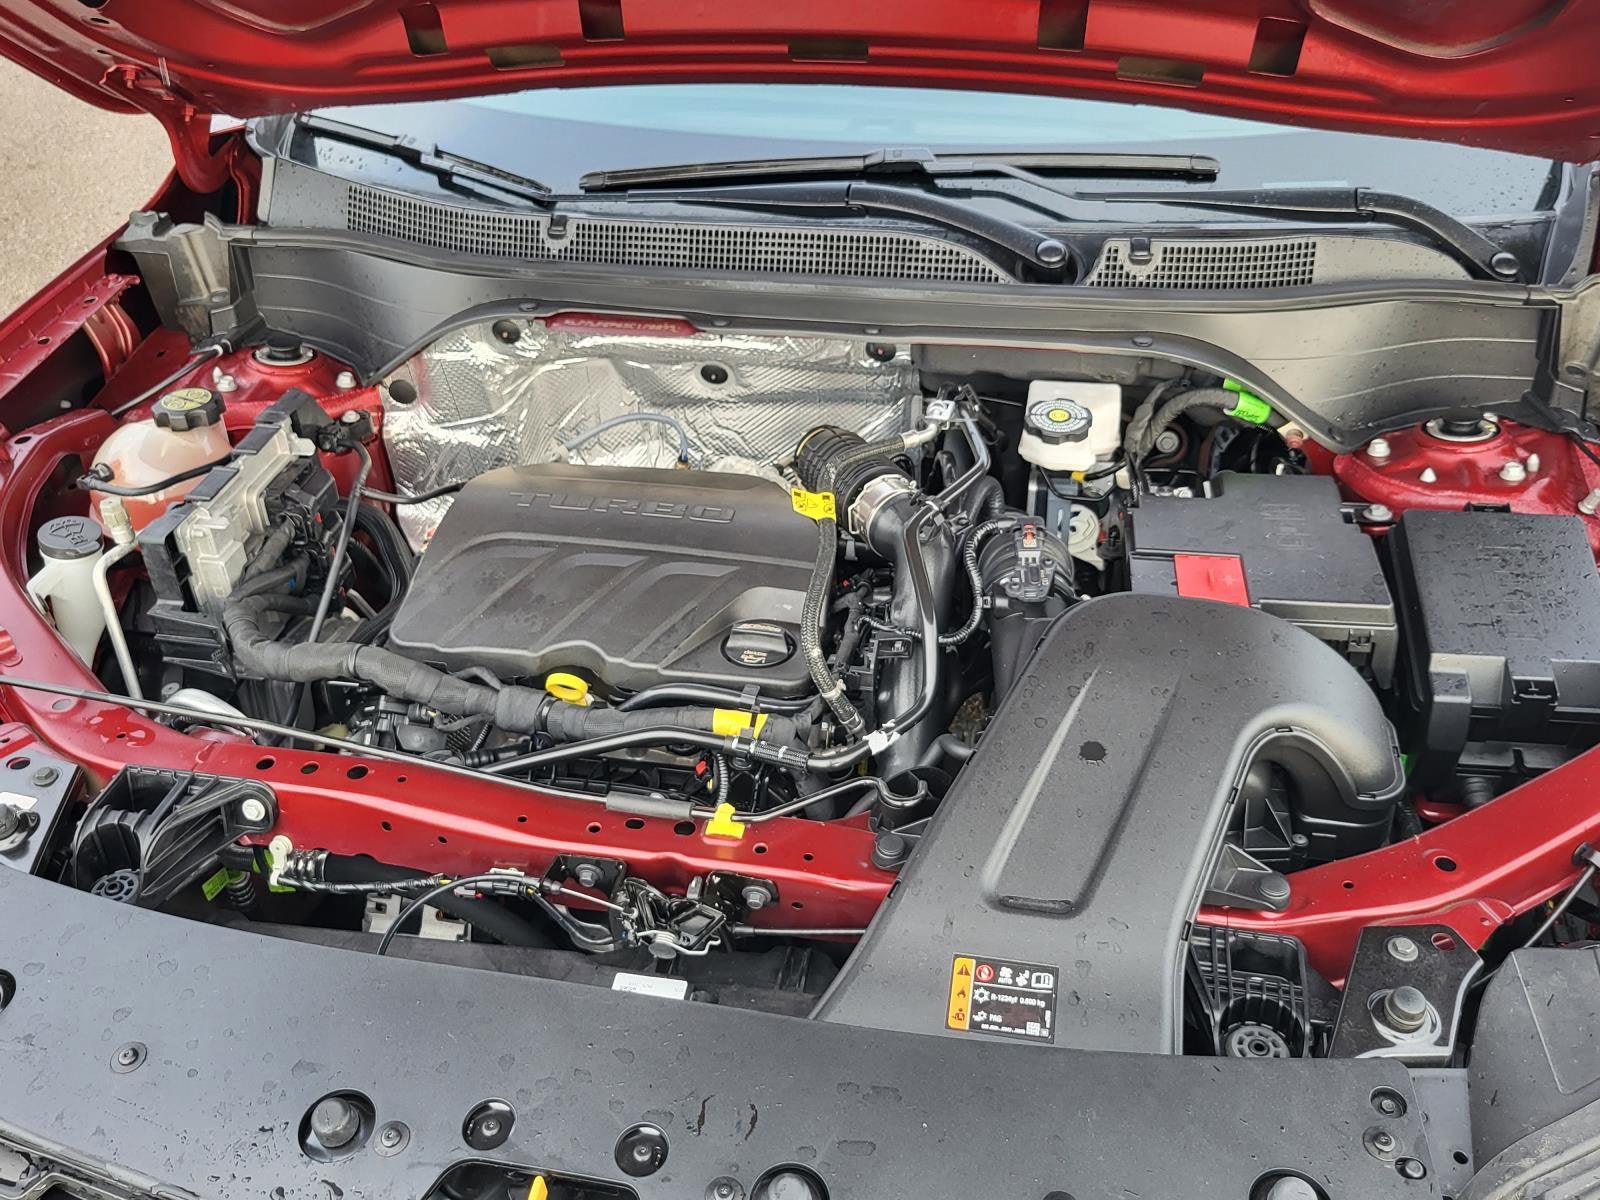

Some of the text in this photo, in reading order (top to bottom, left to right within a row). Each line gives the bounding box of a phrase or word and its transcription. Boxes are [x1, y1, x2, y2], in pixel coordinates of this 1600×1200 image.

[510, 491, 736, 524] TURBO
[998, 977, 1013, 985] AUTO
[1037, 1000, 1046, 1008] kg
